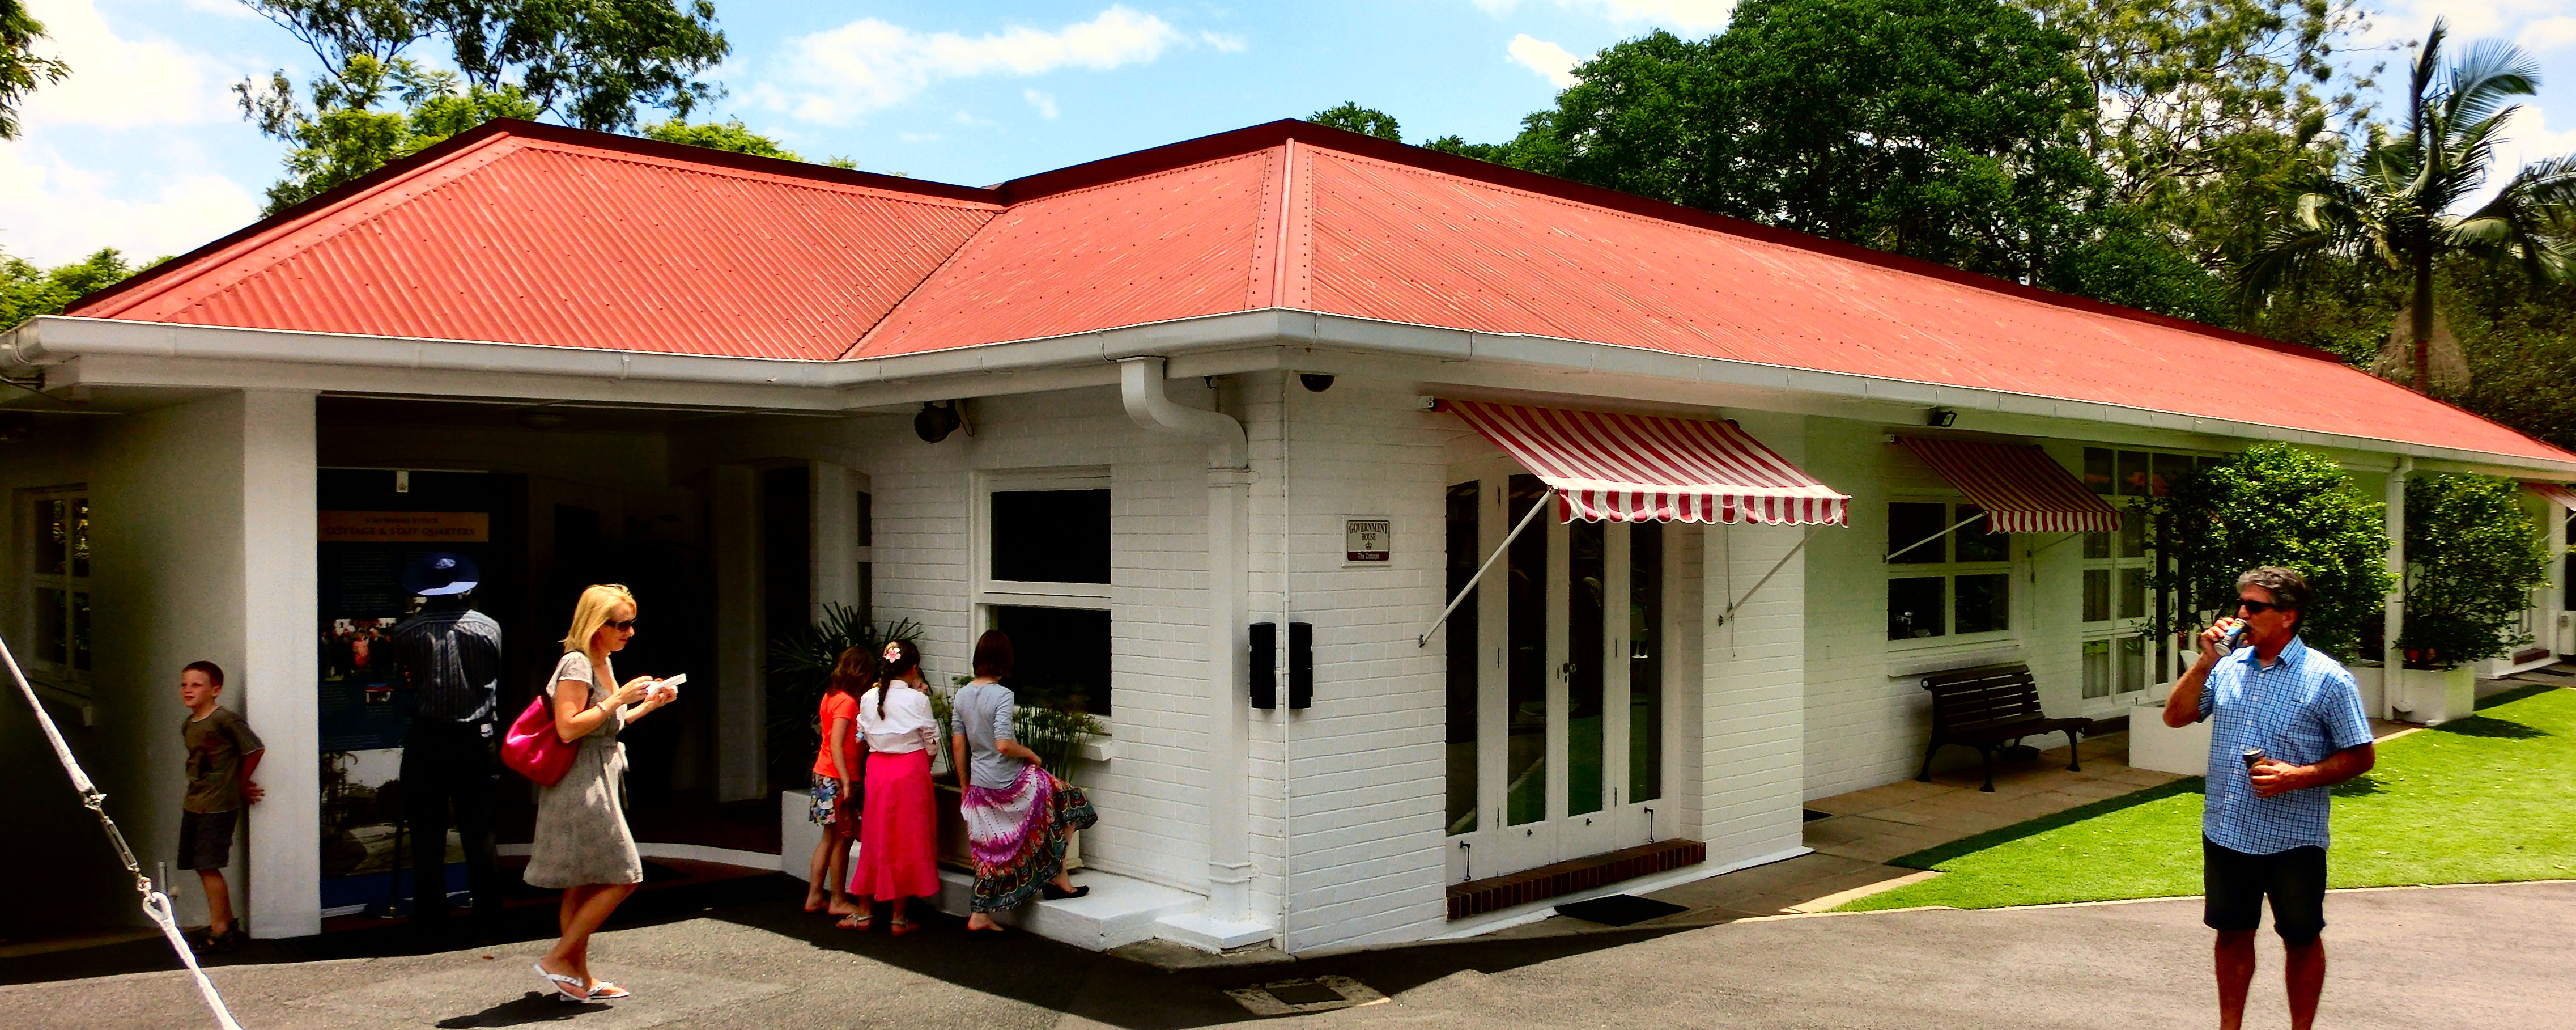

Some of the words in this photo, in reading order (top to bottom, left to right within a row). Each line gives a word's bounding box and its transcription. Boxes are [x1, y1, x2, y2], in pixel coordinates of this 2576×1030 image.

[326, 527, 376, 536] COTTAGE
[422, 527, 474, 536] QUARTERS
[1349, 523, 1387, 534] GOVERNMENT
